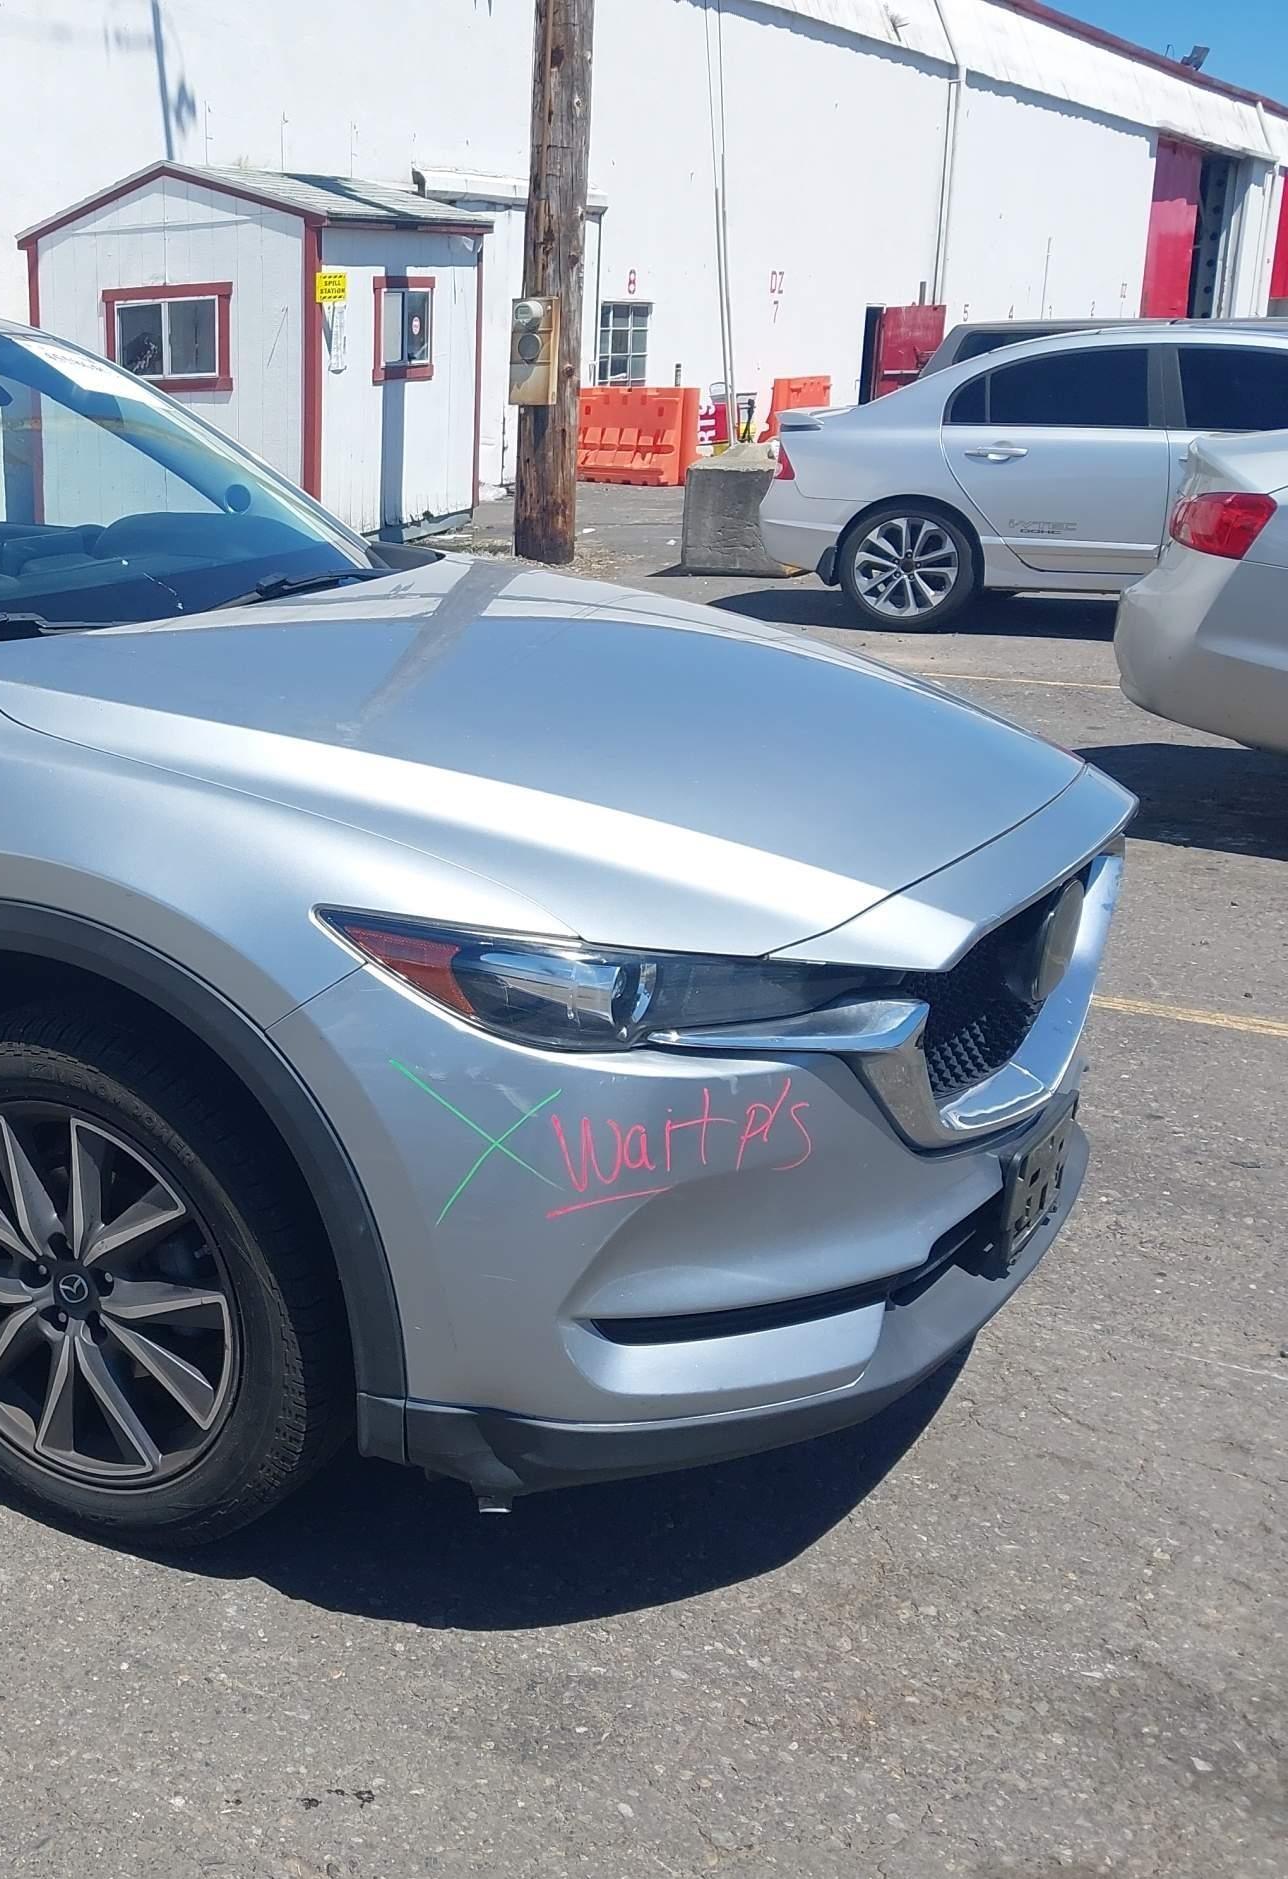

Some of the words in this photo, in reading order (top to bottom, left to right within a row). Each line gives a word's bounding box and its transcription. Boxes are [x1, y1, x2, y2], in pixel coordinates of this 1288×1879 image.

[627, 269, 637, 295] 8
[772, 300, 780, 323] 7
[963, 304, 970, 322] 5
[551, 1087, 736, 1193] Wait
